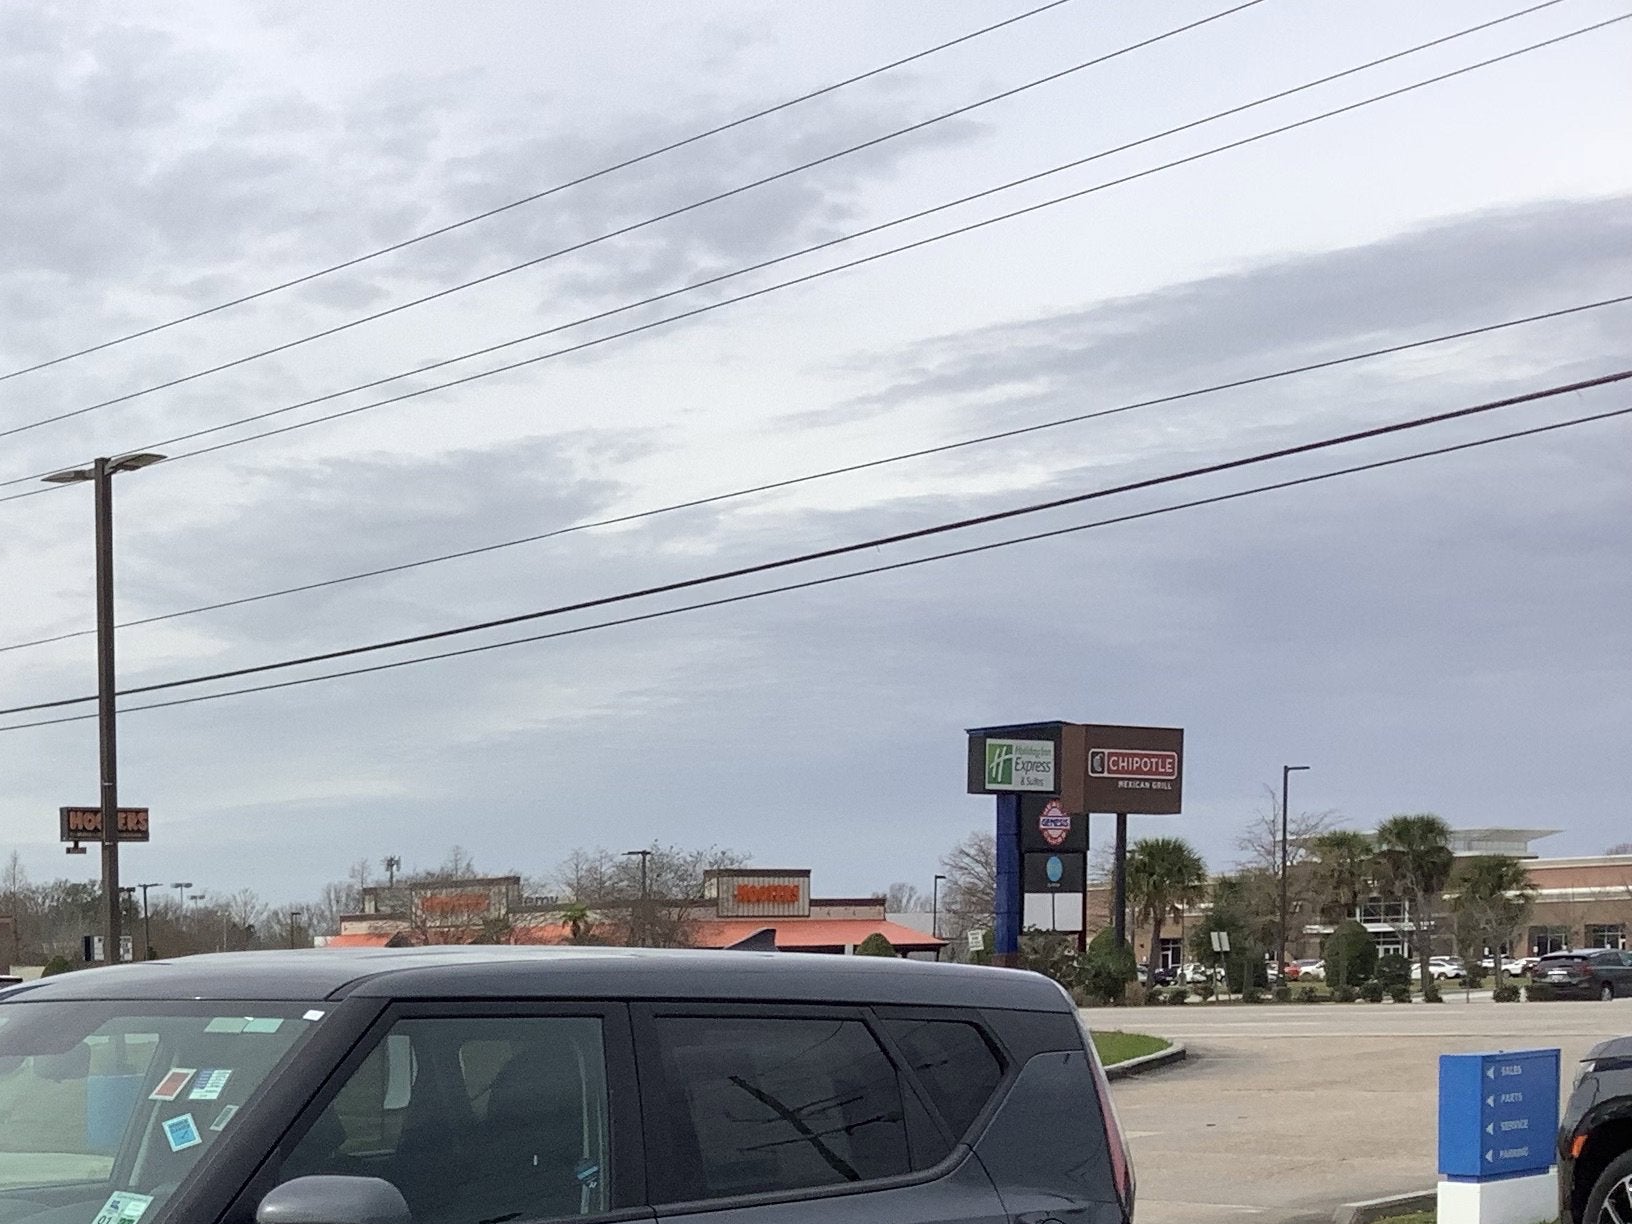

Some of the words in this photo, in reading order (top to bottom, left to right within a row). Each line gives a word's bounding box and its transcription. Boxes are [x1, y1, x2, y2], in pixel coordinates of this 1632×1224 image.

[1014, 756, 1052, 776] Express
[1108, 756, 1174, 773] CHIPOTLE
[1118, 780, 1151, 789] MEXICAN
[1151, 781, 1172, 790] GRILL
[1041, 818, 1068, 827] GENESIS
